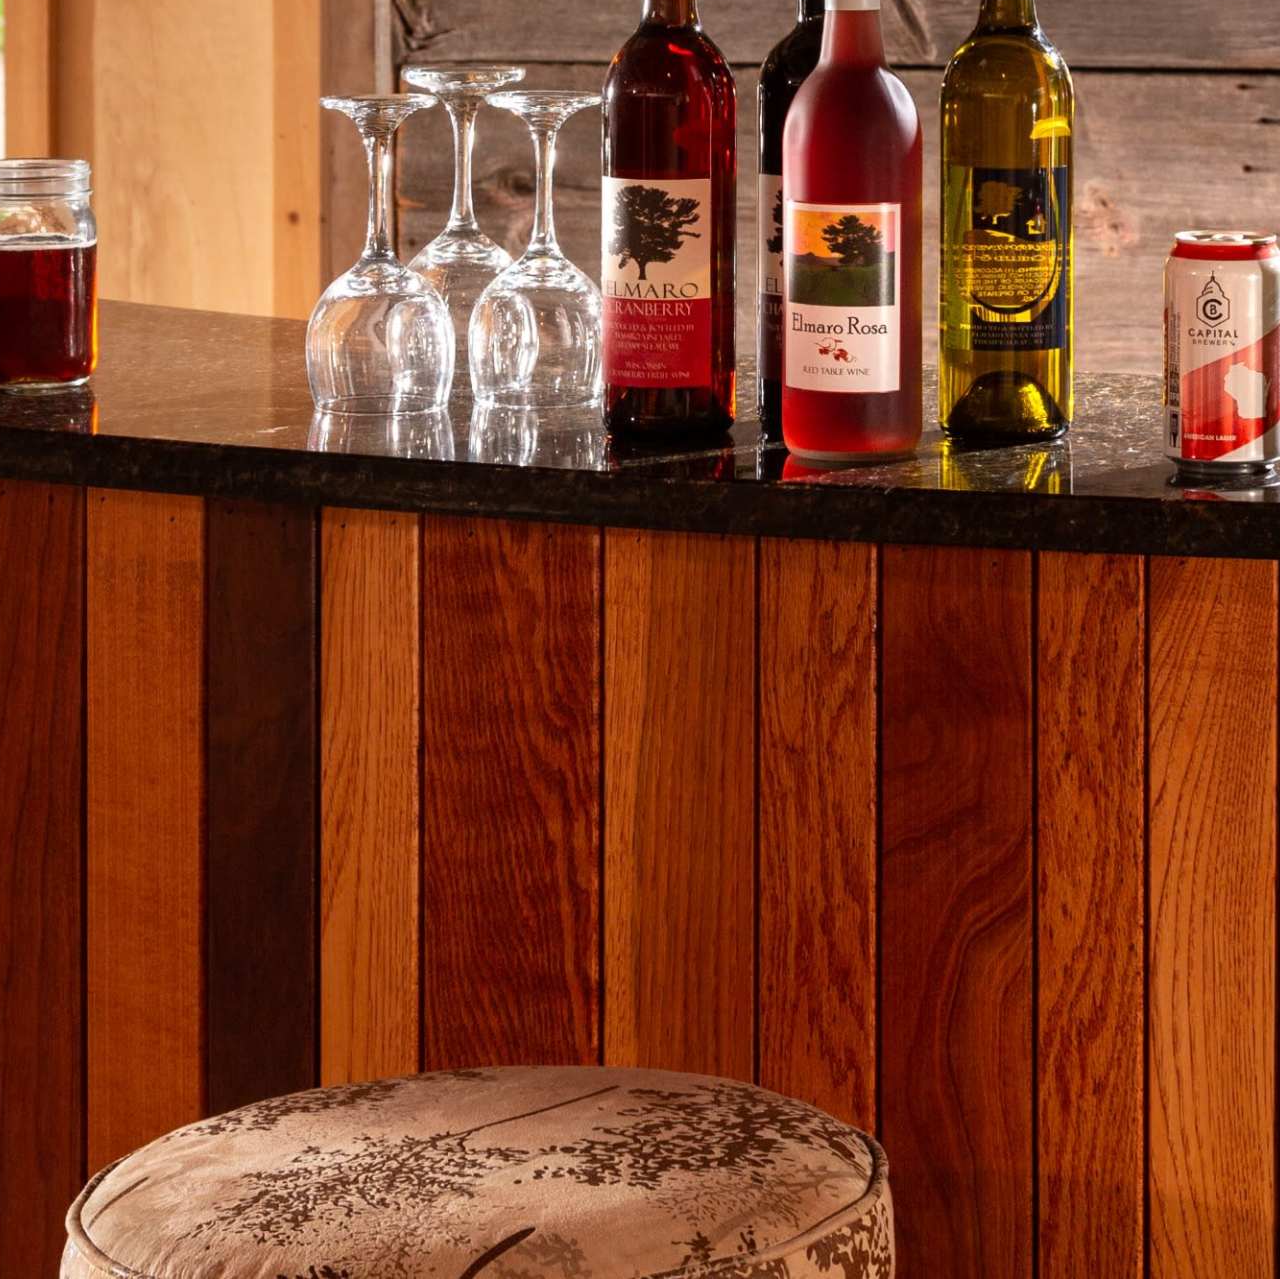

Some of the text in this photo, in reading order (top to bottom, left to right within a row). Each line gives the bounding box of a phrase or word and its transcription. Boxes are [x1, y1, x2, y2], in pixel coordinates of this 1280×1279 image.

[792, 312, 888, 335] Elmaro Rosa
[1187, 328, 1239, 339] CAPITAL
[803, 365, 870, 377] RED TABLE WINE
